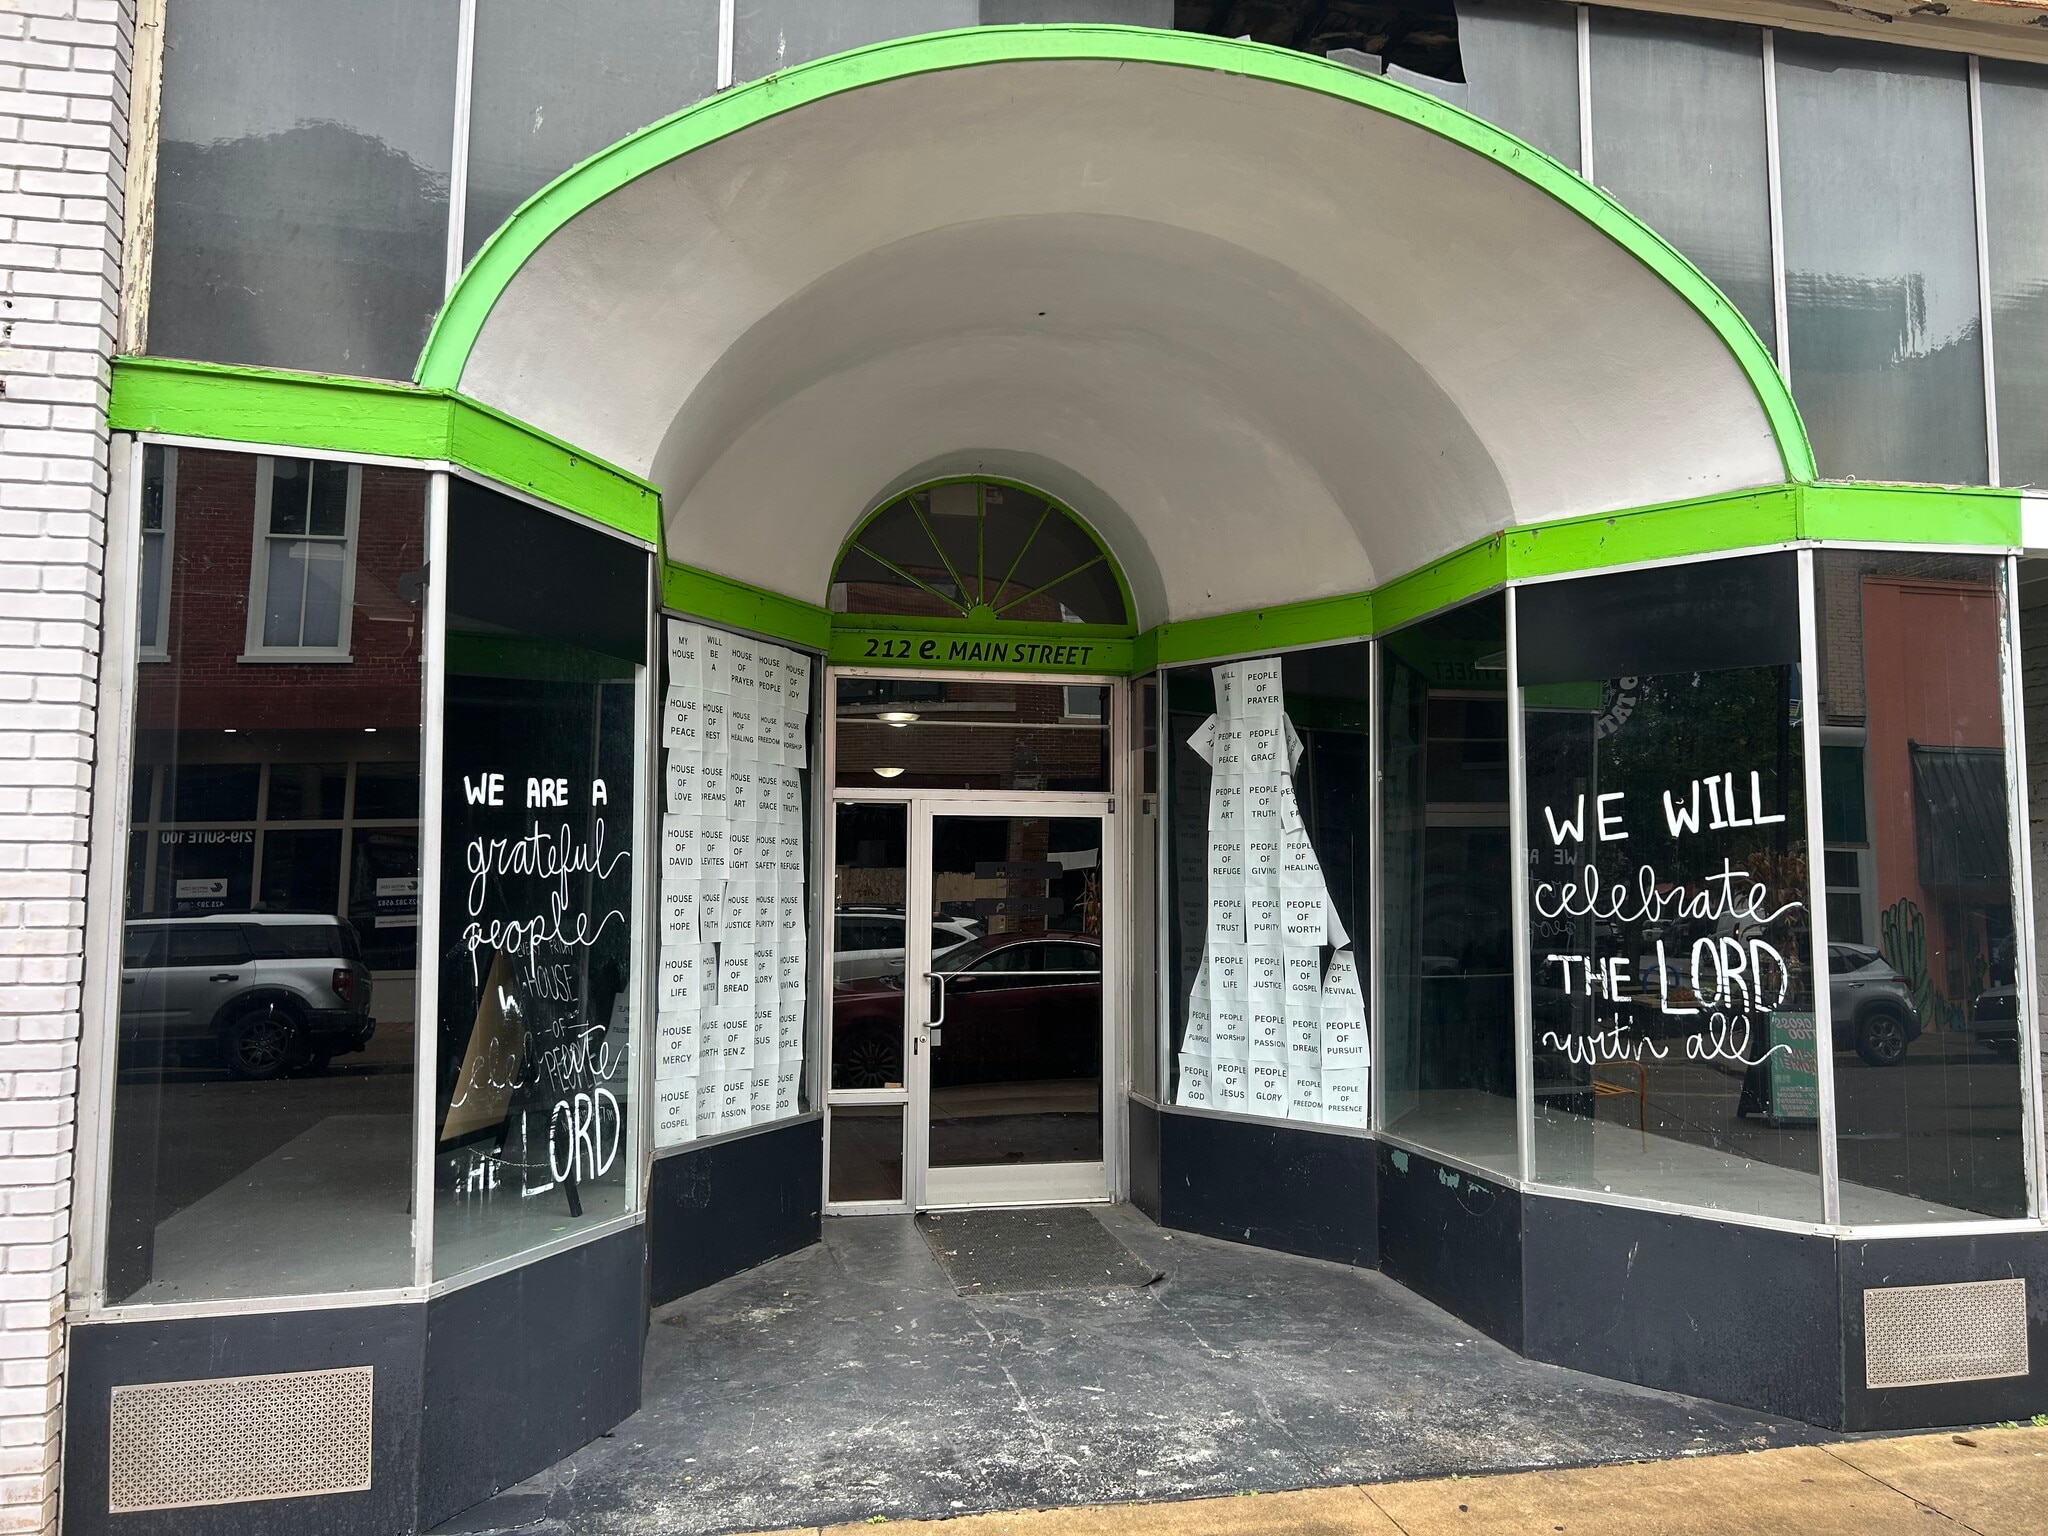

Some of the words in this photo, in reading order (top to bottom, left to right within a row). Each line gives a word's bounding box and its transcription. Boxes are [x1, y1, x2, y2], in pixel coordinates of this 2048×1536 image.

[679, 637, 688, 645] MY
[707, 636, 722, 646] WILL
[672, 650, 694, 659] HOUSE
[710, 650, 718, 658] BE
[732, 650, 752, 661] HOUSE
[864, 638, 910, 658] 212
[949, 641, 1008, 662] MAIN
[1012, 644, 1093, 666] STREET
[759, 656, 780, 667] HOUSE
[786, 664, 804, 676] HOUSE
[1248, 672, 1277, 680] PEOPLE
[732, 675, 754, 686] PRAYER
[759, 681, 781, 693] PEOPLE
[1257, 684, 1266, 692] OF
[788, 690, 799, 699] JOY
[1248, 696, 1278, 704] PRAYER
[670, 699, 696, 710] HOUSE
[703, 704, 723, 713] HOUSE
[678, 714, 688, 722] OF
[671, 727, 695, 737] PEACE
[706, 731, 720, 739] REST
[1218, 732, 1241, 740] PEOPLE
[1250, 729, 1278, 737] PEOPLE
[1258, 741, 1268, 749] OF
[1251, 753, 1276, 761] GRACE
[671, 764, 694, 774] HOUSE
[731, 773, 750, 782] HOUSE
[759, 777, 777, 785] HOUSE
[464, 773, 504, 806] WE
[527, 778, 568, 808] ARE
[592, 779, 608, 806] A
[675, 792, 692, 801] LOVE
[759, 802, 777, 810] GRACE
[1545, 792, 1629, 845] WE
[1663, 771, 1785, 838] WILL
[668, 830, 693, 838] HOUSE
[702, 831, 722, 839] HOUSE
[757, 836, 776, 844] HOUSE
[676, 843, 685, 852] OF
[670, 857, 693, 865] DAVID
[729, 861, 748, 869] LIGHT
[467, 818, 630, 916] grateful
[1535, 858, 1802, 922] celebrate
[667, 895, 692, 903] HOUSE
[728, 896, 748, 904] HOUSE
[756, 896, 774, 904] HOUSE
[675, 908, 684, 917] OF
[1297, 913, 1309, 921] OF
[670, 922, 690, 930] HOPE
[725, 921, 751, 929] JUSTICE
[1254, 923, 1280, 931] PURITY
[463, 891, 625, 986] people
[665, 960, 692, 968] HOUSE
[1255, 958, 1279, 966] PEOPLE
[1290, 960, 1317, 968] PEOPLE
[731, 971, 740, 979] OF
[1225, 968, 1234, 976] OF
[1300, 972, 1310, 980] OF
[1547, 954, 1632, 1002] THE
[1656, 936, 1788, 1015] LORD
[673, 974, 683, 982] OF
[524, 964, 578, 1002] HOUSE
[1254, 981, 1281, 989] JUSTICE
[724, 984, 748, 992] BREAD
[1293, 984, 1317, 992] GOSPEL
[1324, 986, 1356, 994] REVIVAL
[671, 988, 687, 997] LIFE
[1255, 1015, 1284, 1024] PEOPLE
[552, 1018, 566, 1038] OF
[1293, 1021, 1317, 1029] PEOPLE
[1326, 1022, 1360, 1030] PEOPLE
[663, 1026, 691, 1036] HOUSE
[728, 1034, 738, 1042] OF
[1686, 1012, 1792, 1065] all
[671, 1041, 682, 1050] OF
[1255, 1039, 1285, 1048] PASSION
[724, 1048, 738, 1056] GEN
[739, 1047, 745, 1055] Z
[1293, 1044, 1318, 1053] DREAMS
[1327, 1046, 1362, 1054] PURSUIT
[663, 1055, 691, 1064] MERCY
[1185, 1066, 1208, 1077] PEOPLE
[1218, 1064, 1247, 1074] PEOPLE
[1255, 1067, 1286, 1077] PEOPLE
[1226, 1077, 1237, 1085] OF
[1264, 1080, 1275, 1088] OF
[1297, 1080, 1321, 1088] PEOPLE
[661, 1091, 689, 1101] HOUSE
[1189, 1092, 1204, 1100] GOD
[1220, 1089, 1244, 1098] JESUS
[1256, 1092, 1282, 1102] GLORY
[1294, 1100, 1323, 1108] FREEDOM
[669, 1106, 680, 1115] OF
[661, 1119, 688, 1129] GOSPEL
[521, 1088, 620, 1198] LORD
